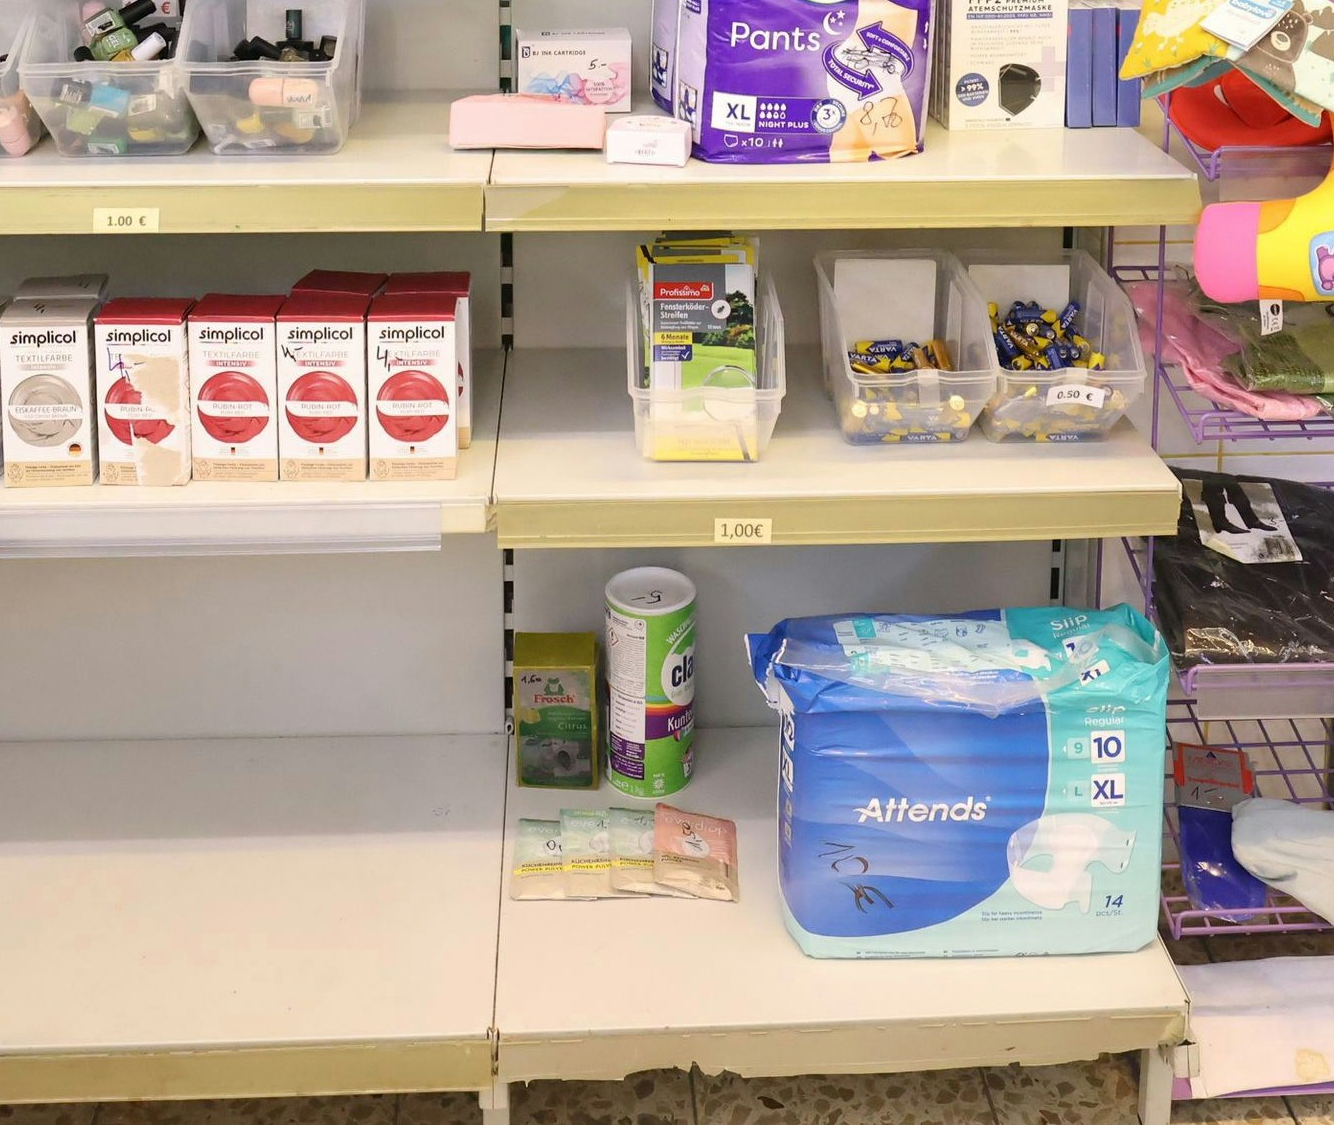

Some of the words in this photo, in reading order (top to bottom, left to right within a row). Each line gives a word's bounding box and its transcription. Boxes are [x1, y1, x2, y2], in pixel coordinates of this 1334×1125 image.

[968, 4, 1053, 13] ATEMSCHUTZMASKE
[730, 21, 822, 56] Pants
[553, 48, 587, 56] CARTRIDGE
[727, 101, 752, 120] XL
[757, 119, 785, 129] NIGHT
[786, 119, 811, 129] PLUS
[741, 136, 764, 147] x10
[107, 215, 133, 227] 1.00
[138, 215, 147, 227] €
[660, 286, 700, 296] Profissimo
[660, 302, 710, 311] Fensterköder-
[660, 310, 689, 319] Streifen
[9, 330, 76, 348] simplicol
[106, 330, 172, 346] simplicol
[199, 327, 265, 344] simplicol
[287, 327, 354, 344] simplicol
[379, 325, 445, 343] simplicol
[203, 350, 261, 360] TEXTILFARBE
[869, 346, 898, 355] VARTA
[16, 355, 73, 363] TEXTILFARBE
[849, 352, 878, 363] VARTA
[1057, 390, 1080, 400] 0.50
[212, 403, 252, 411] RUBIN-ROT
[907, 434, 938, 442] VARTA
[1048, 433, 1079, 442] VARTA
[720, 523, 764, 540] 1,00€
[1050, 613, 1088, 632] Slip
[533, 693, 575, 705] Frosch
[557, 721, 588, 731] Citrus
[1083, 716, 1125, 728] Regular
[1074, 742, 1084, 755] 9
[1092, 736, 1122, 759] 10
[1092, 779, 1124, 800] XL
[853, 796, 989, 823] Attends
[1105, 894, 1124, 908] 14
